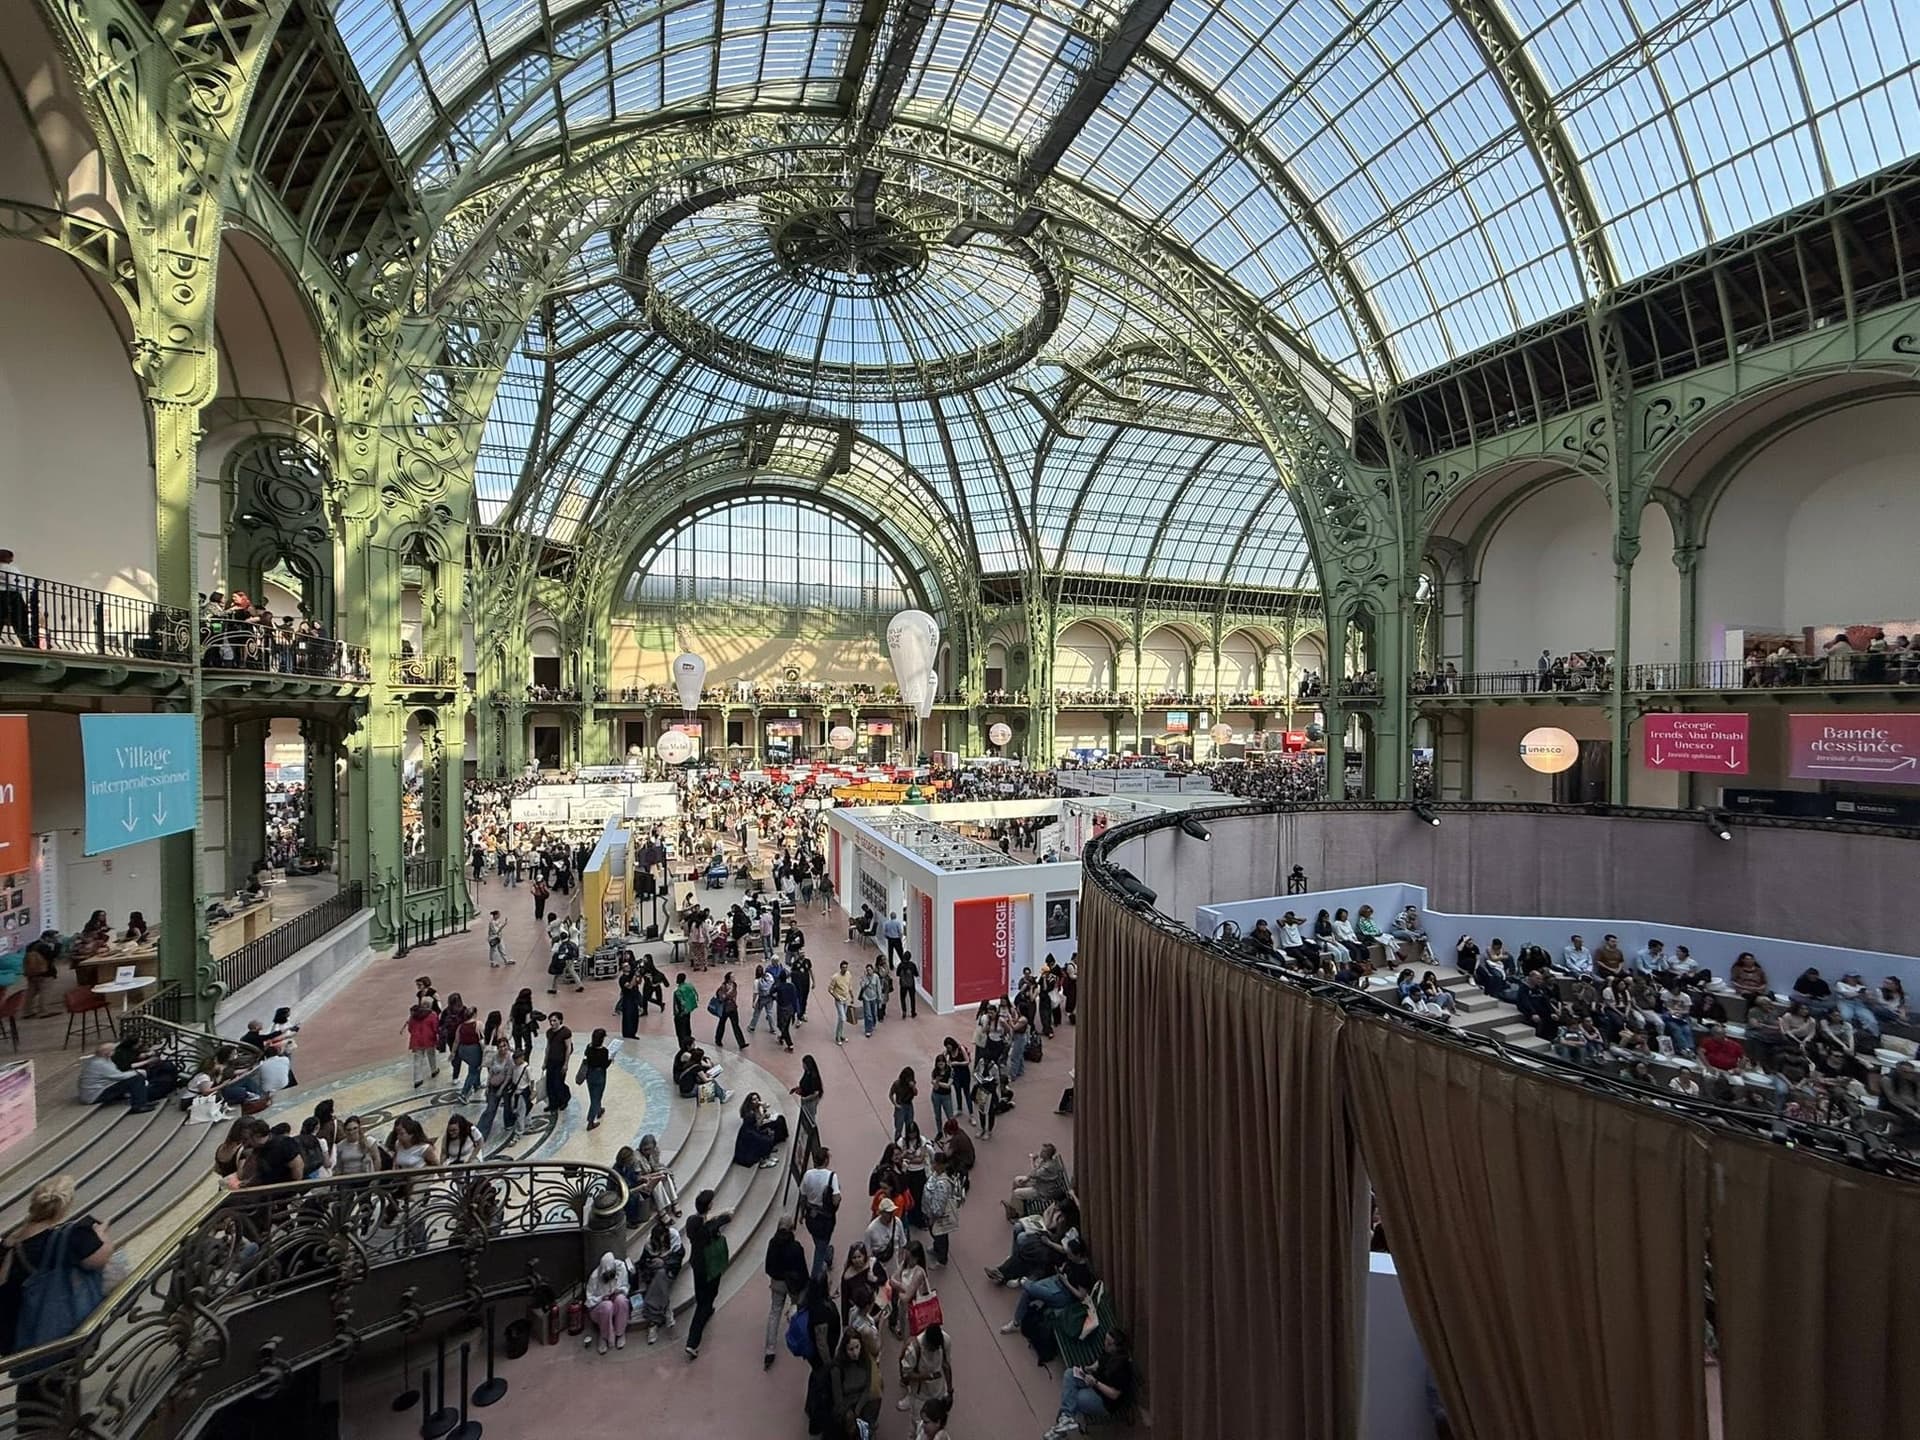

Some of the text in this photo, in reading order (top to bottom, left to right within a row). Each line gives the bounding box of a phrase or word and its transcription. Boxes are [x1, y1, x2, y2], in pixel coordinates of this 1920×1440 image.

[1687, 731, 1707, 740] Abu
[1711, 731, 1743, 740] Dhabi
[1823, 726, 1889, 740] Bande
[1674, 741, 1714, 750] Unesco
[1811, 739, 1904, 753] dessinée
[116, 746, 171, 770] Village
[91, 769, 190, 796] interprofessionnel
[993, 901, 1007, 958] GÉORGIE
